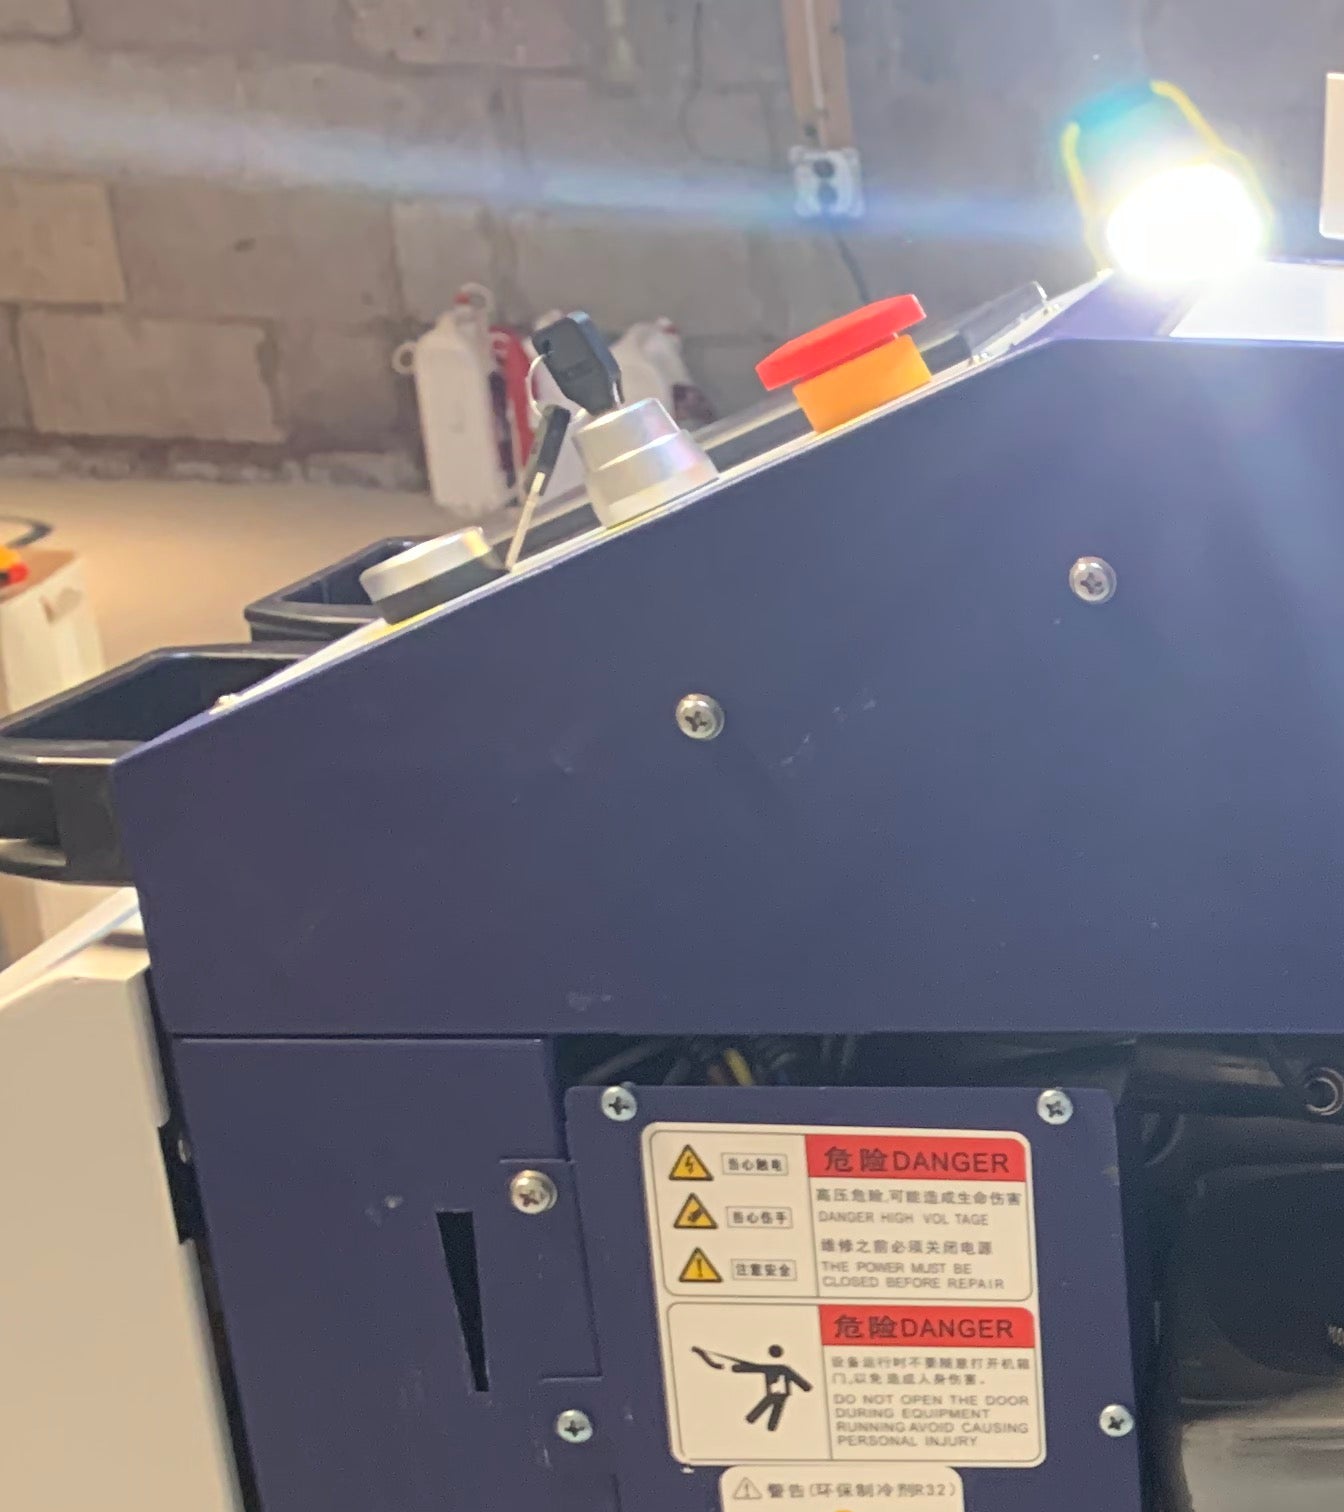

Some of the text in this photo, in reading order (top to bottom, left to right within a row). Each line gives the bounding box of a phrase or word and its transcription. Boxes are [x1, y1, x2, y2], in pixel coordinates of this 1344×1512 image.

[818, 1210, 874, 1224] DANGER
[881, 1211, 914, 1224] HIGH
[820, 1261, 973, 1275] THE POWER MUST BE
[822, 1276, 1005, 1290] CLOSED BEFORE REPAIR
[833, 1393, 1030, 1407] DO NOT OPEN THE DOOR
[835, 1407, 991, 1420] DURING EQUIPMENT
[836, 1421, 1030, 1434] RUNNING AVOID CAUSING
[837, 1435, 979, 1447] PERSONAL INJURY
